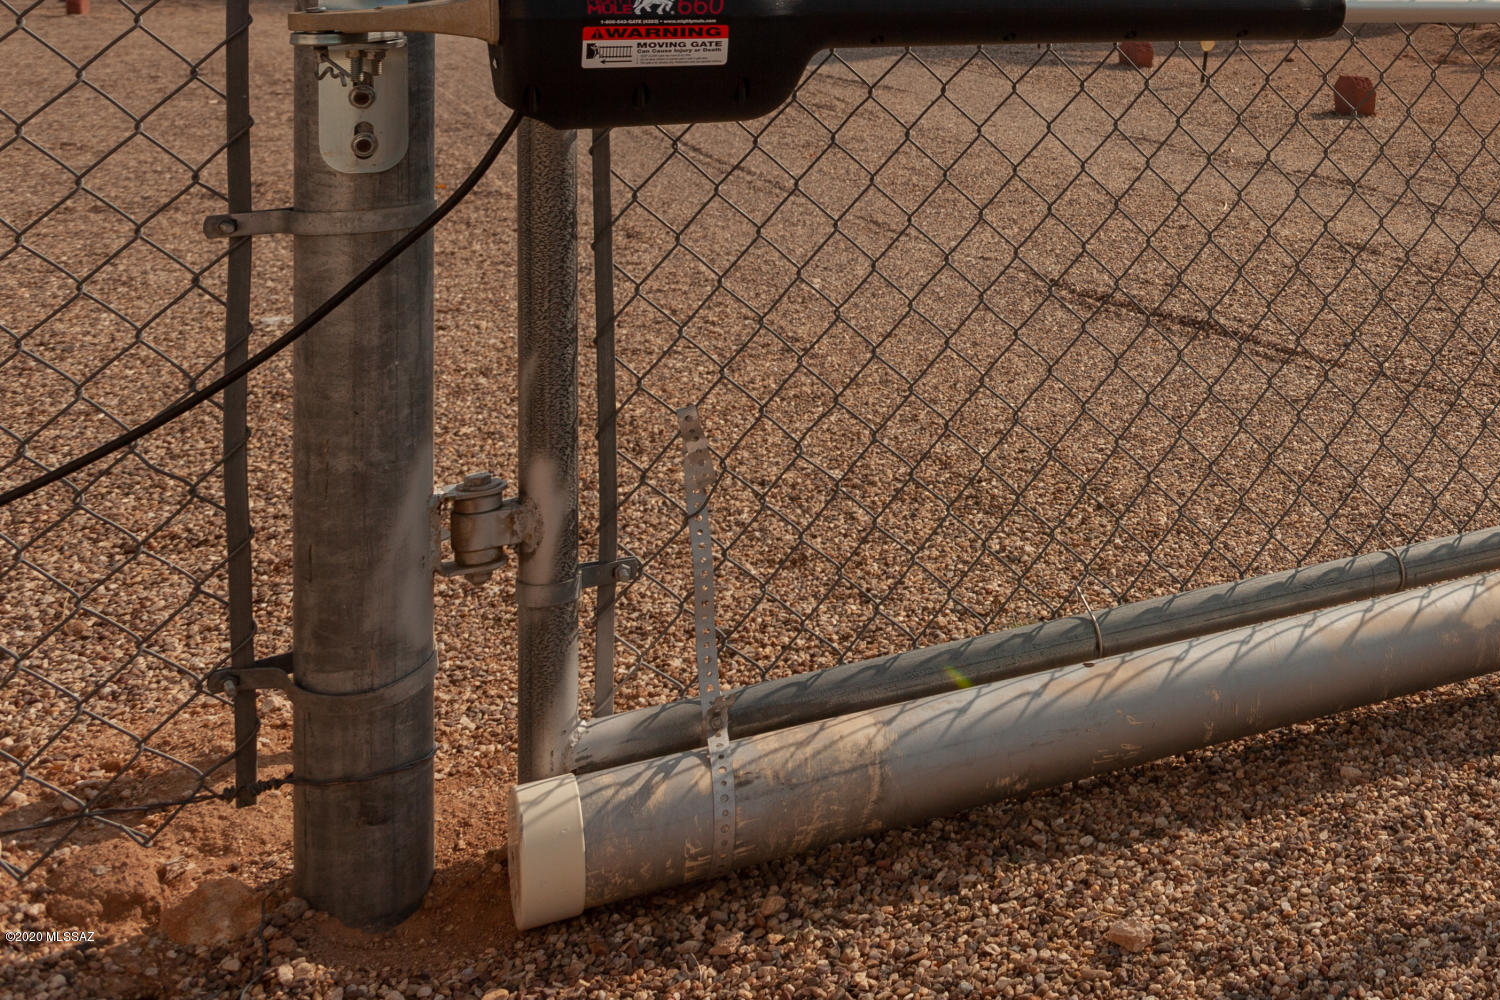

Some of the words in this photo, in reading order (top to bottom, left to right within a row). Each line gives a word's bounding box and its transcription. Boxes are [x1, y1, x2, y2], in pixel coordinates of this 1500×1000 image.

[587, 3, 633, 15] MULE
[605, 26, 722, 39] WARNING
[636, 41, 687, 49] MOVING
[694, 40, 723, 48] GATE
